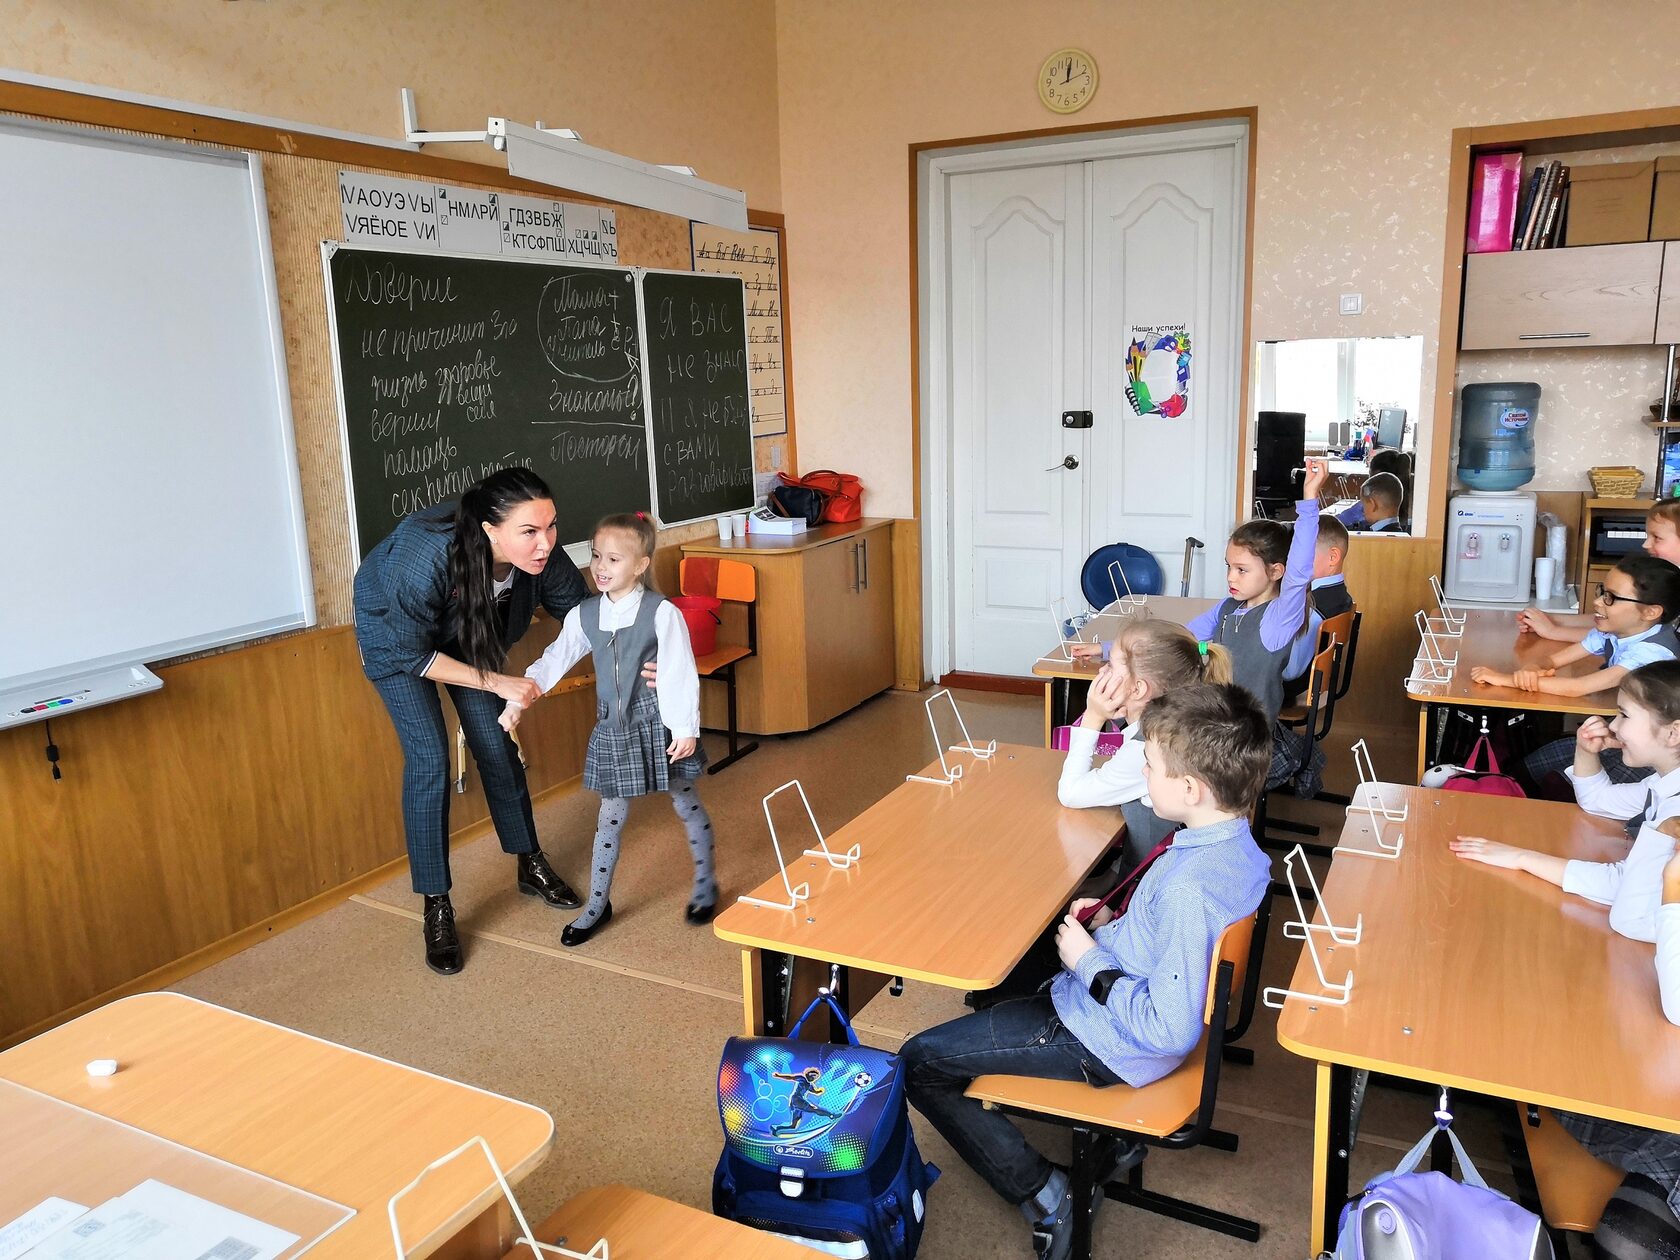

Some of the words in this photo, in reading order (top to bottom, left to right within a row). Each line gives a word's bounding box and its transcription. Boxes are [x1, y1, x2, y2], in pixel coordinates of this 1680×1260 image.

[1057, 60, 1064, 69] 11
[1081, 64, 1087, 74] 2
[1049, 66, 1057, 77] 10
[1046, 78, 1052, 87] 9
[1084, 75, 1090, 86] 3
[1049, 88, 1055, 98] 8
[1080, 87, 1086, 96] 4
[1056, 94, 1062, 104] 7
[1063, 96, 1070, 106] 6
[1072, 93, 1079, 103] 5
[509, 207, 564, 228] ГДЗВБЖ
[512, 233, 565, 253] КТСФПШ
[568, 238, 600, 257] ХЦЧЩ
[1131, 324, 1154, 333] Наши
[1155, 323, 1186, 333] успехи!
